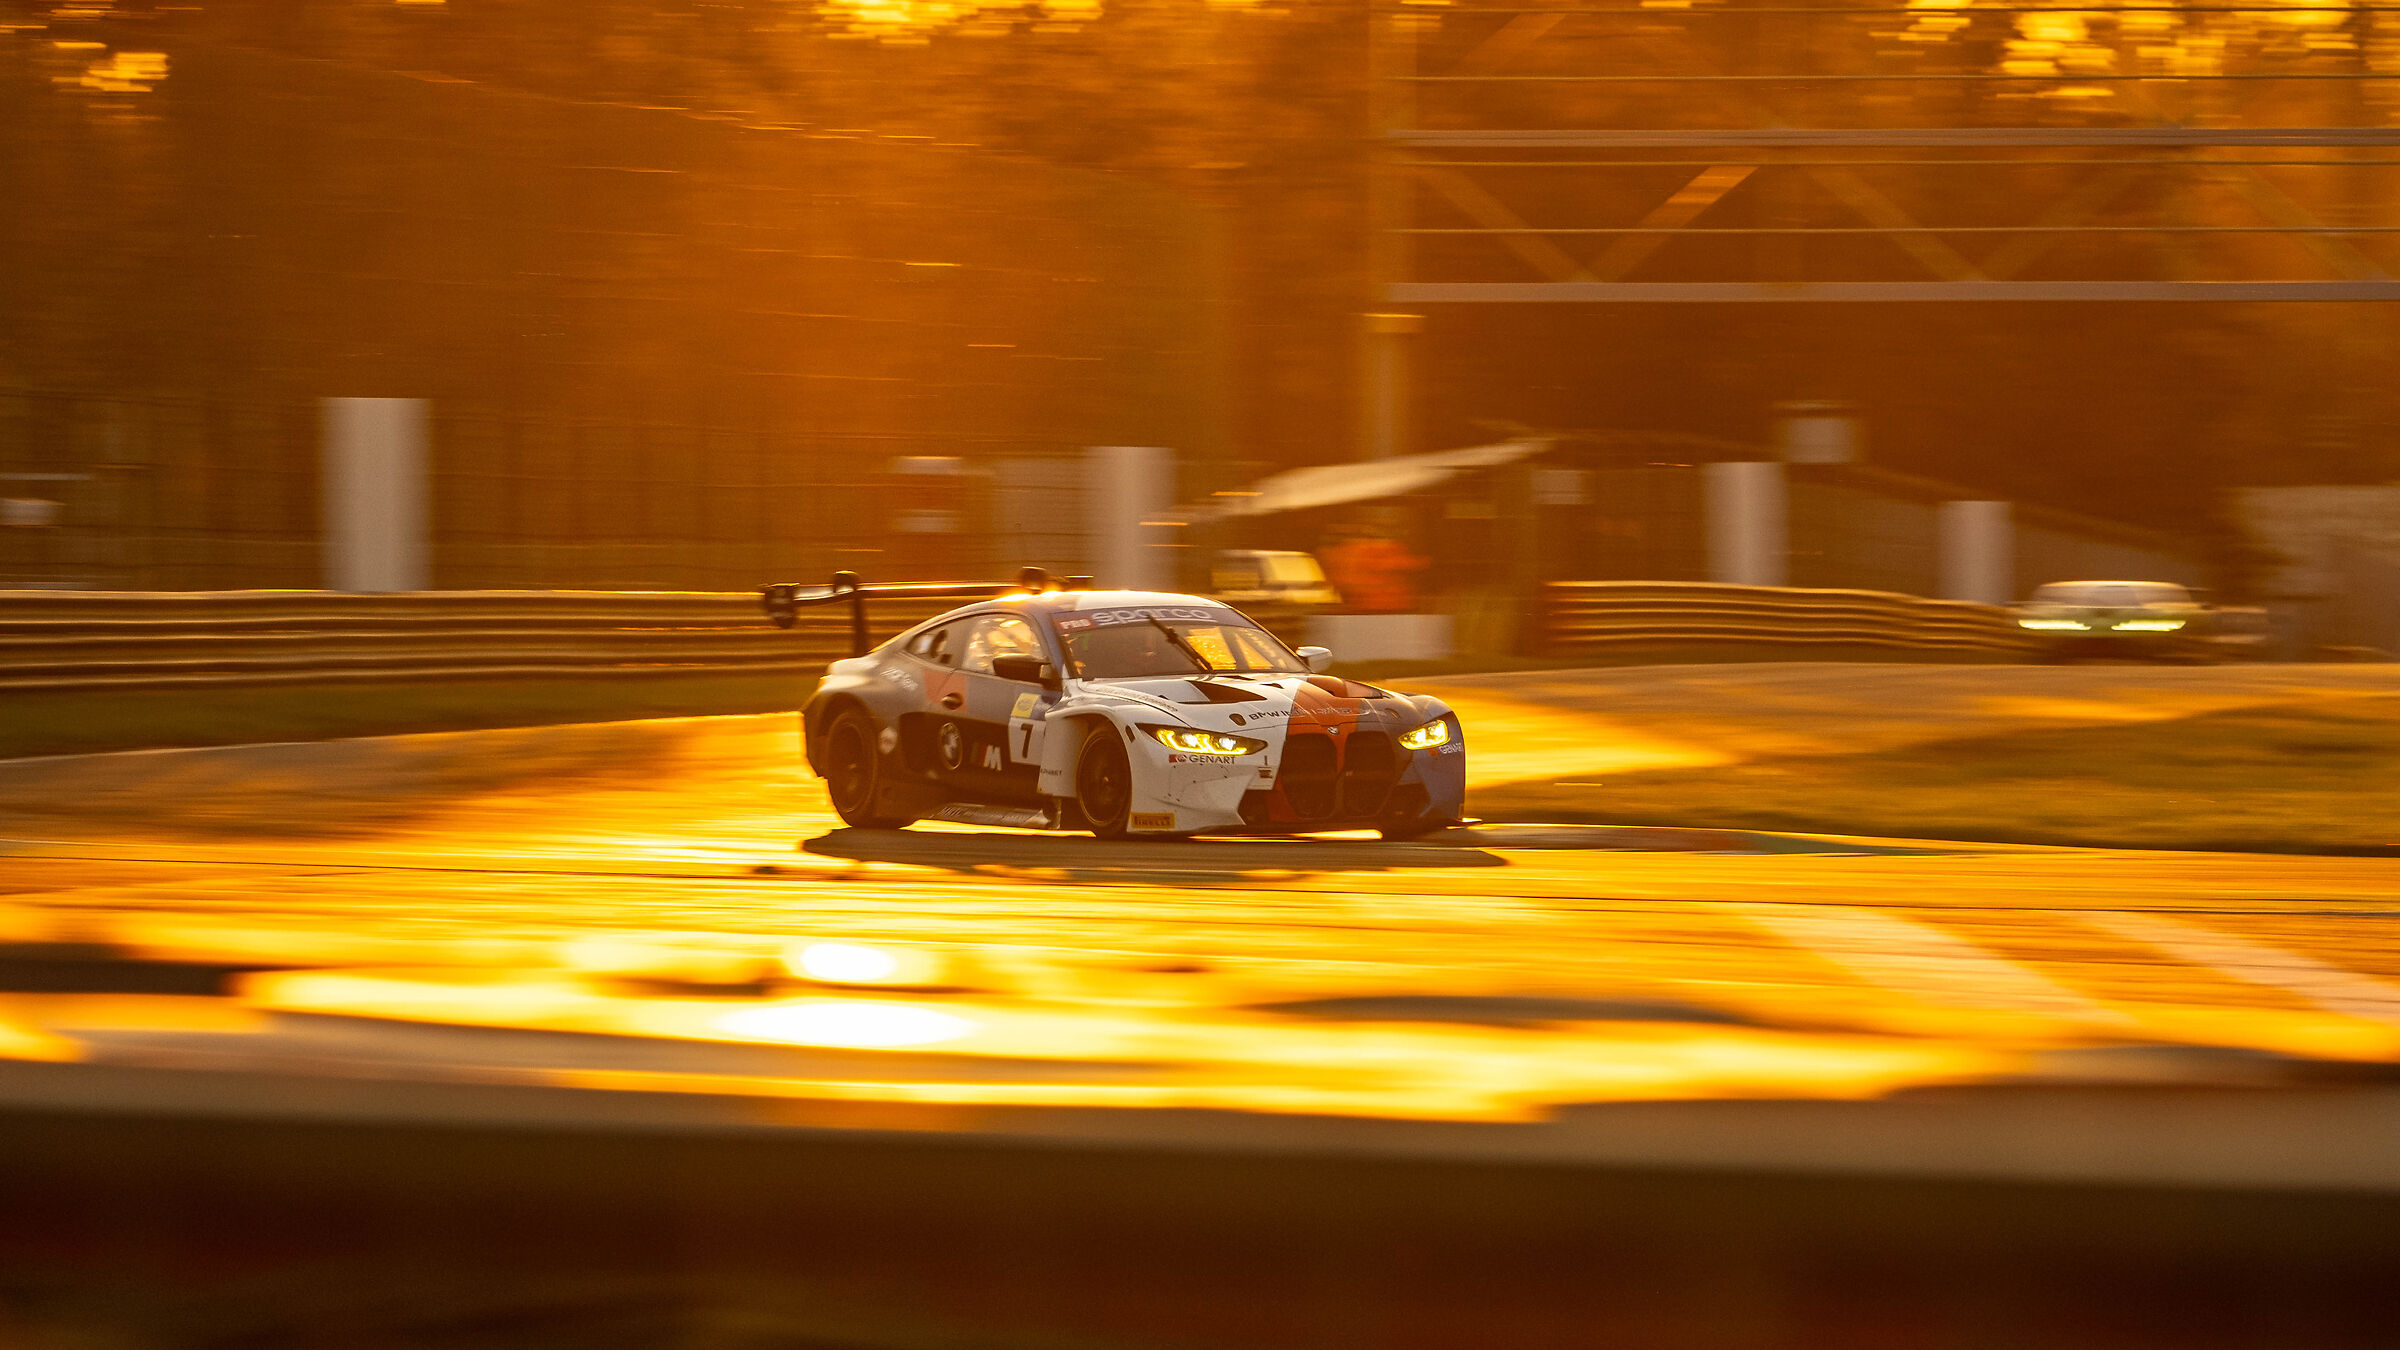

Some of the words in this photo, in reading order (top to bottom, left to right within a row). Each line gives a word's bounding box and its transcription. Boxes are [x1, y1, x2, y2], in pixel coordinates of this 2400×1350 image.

[1091, 608, 1213, 624] sparco
[1020, 722, 1034, 759] 7
[983, 744, 1002, 772] M
[1188, 754, 1236, 765] GENART
